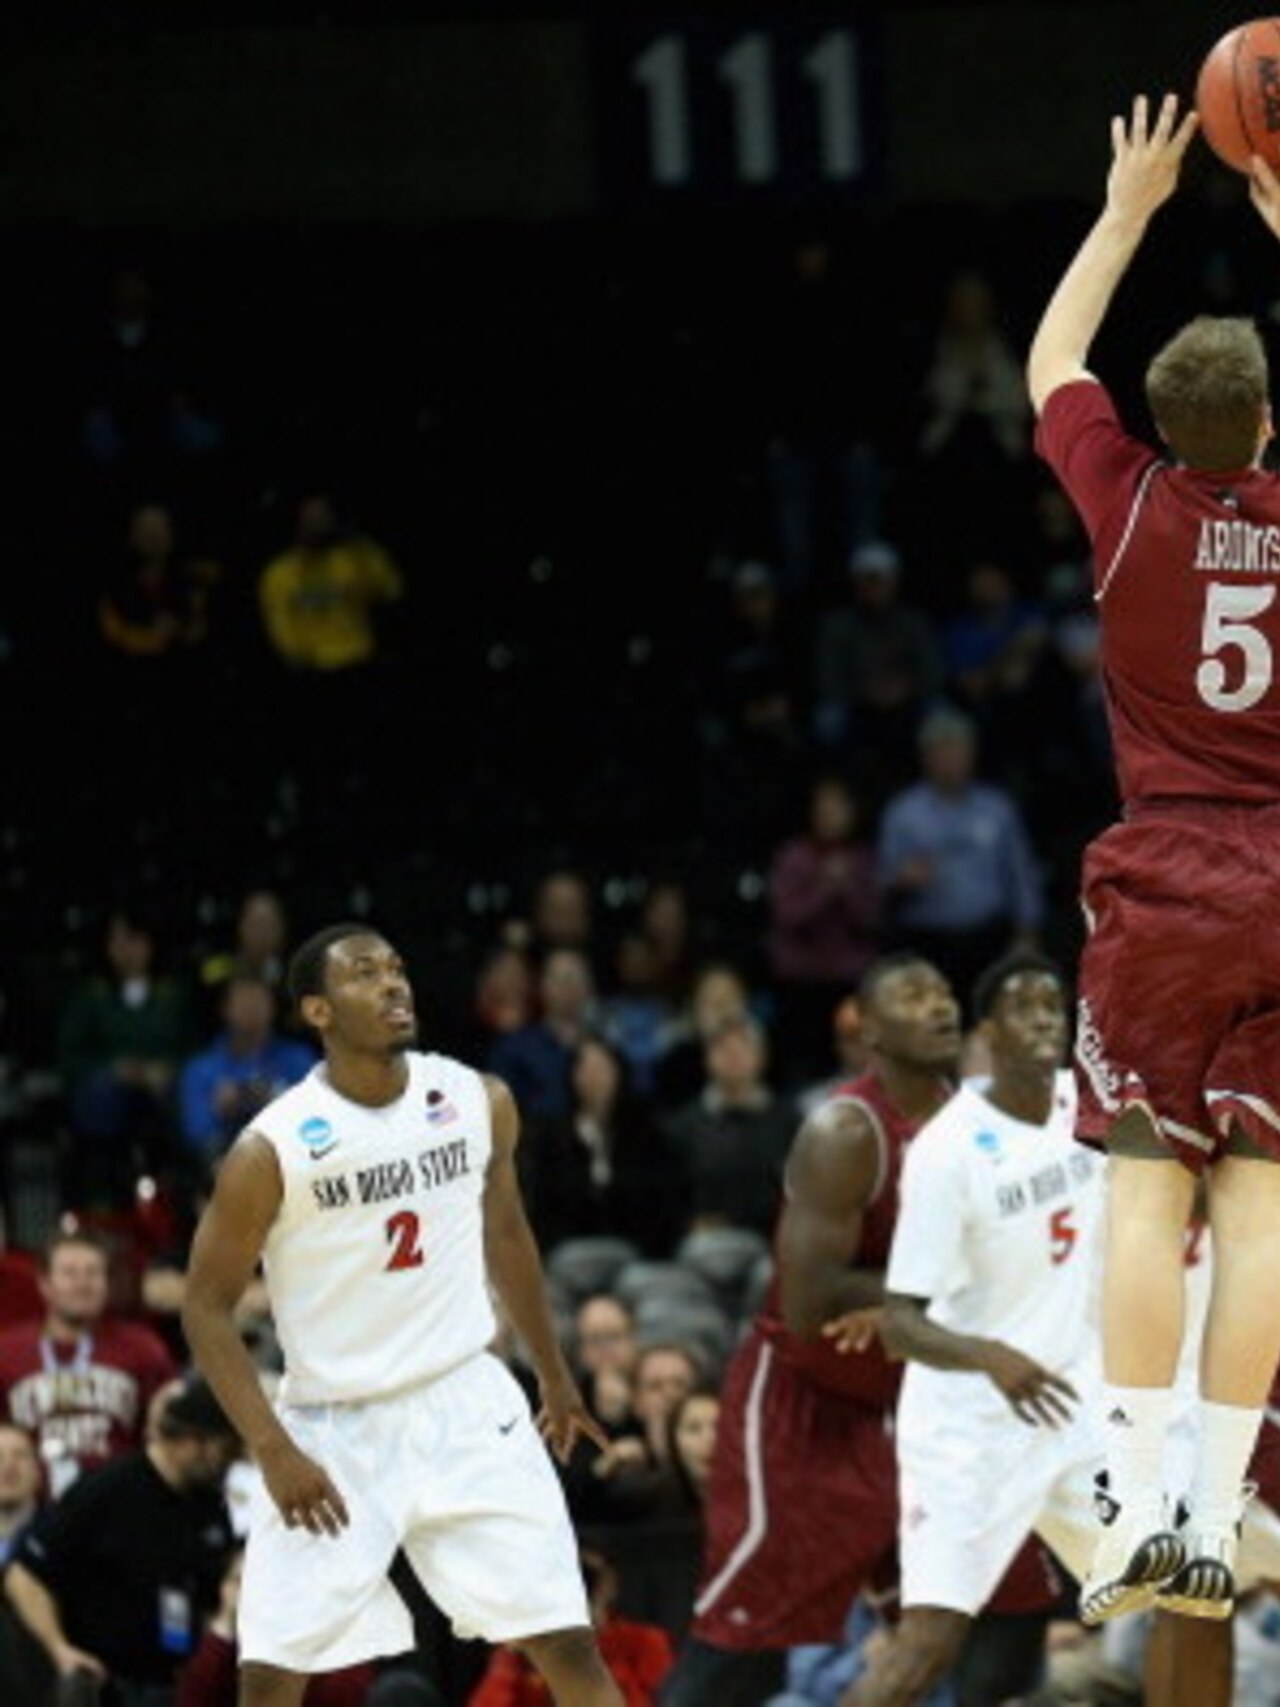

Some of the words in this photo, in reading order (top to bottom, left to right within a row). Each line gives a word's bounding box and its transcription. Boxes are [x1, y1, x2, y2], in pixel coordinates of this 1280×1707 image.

[631, 33, 863, 182] 111
[1196, 580, 1277, 713] 5
[311, 1175, 350, 1211] SAN
[357, 1159, 414, 1204] DIEGO
[419, 1138, 469, 1189] STATE
[384, 1210, 424, 1271] 2
[1049, 1205, 1077, 1266] 5
